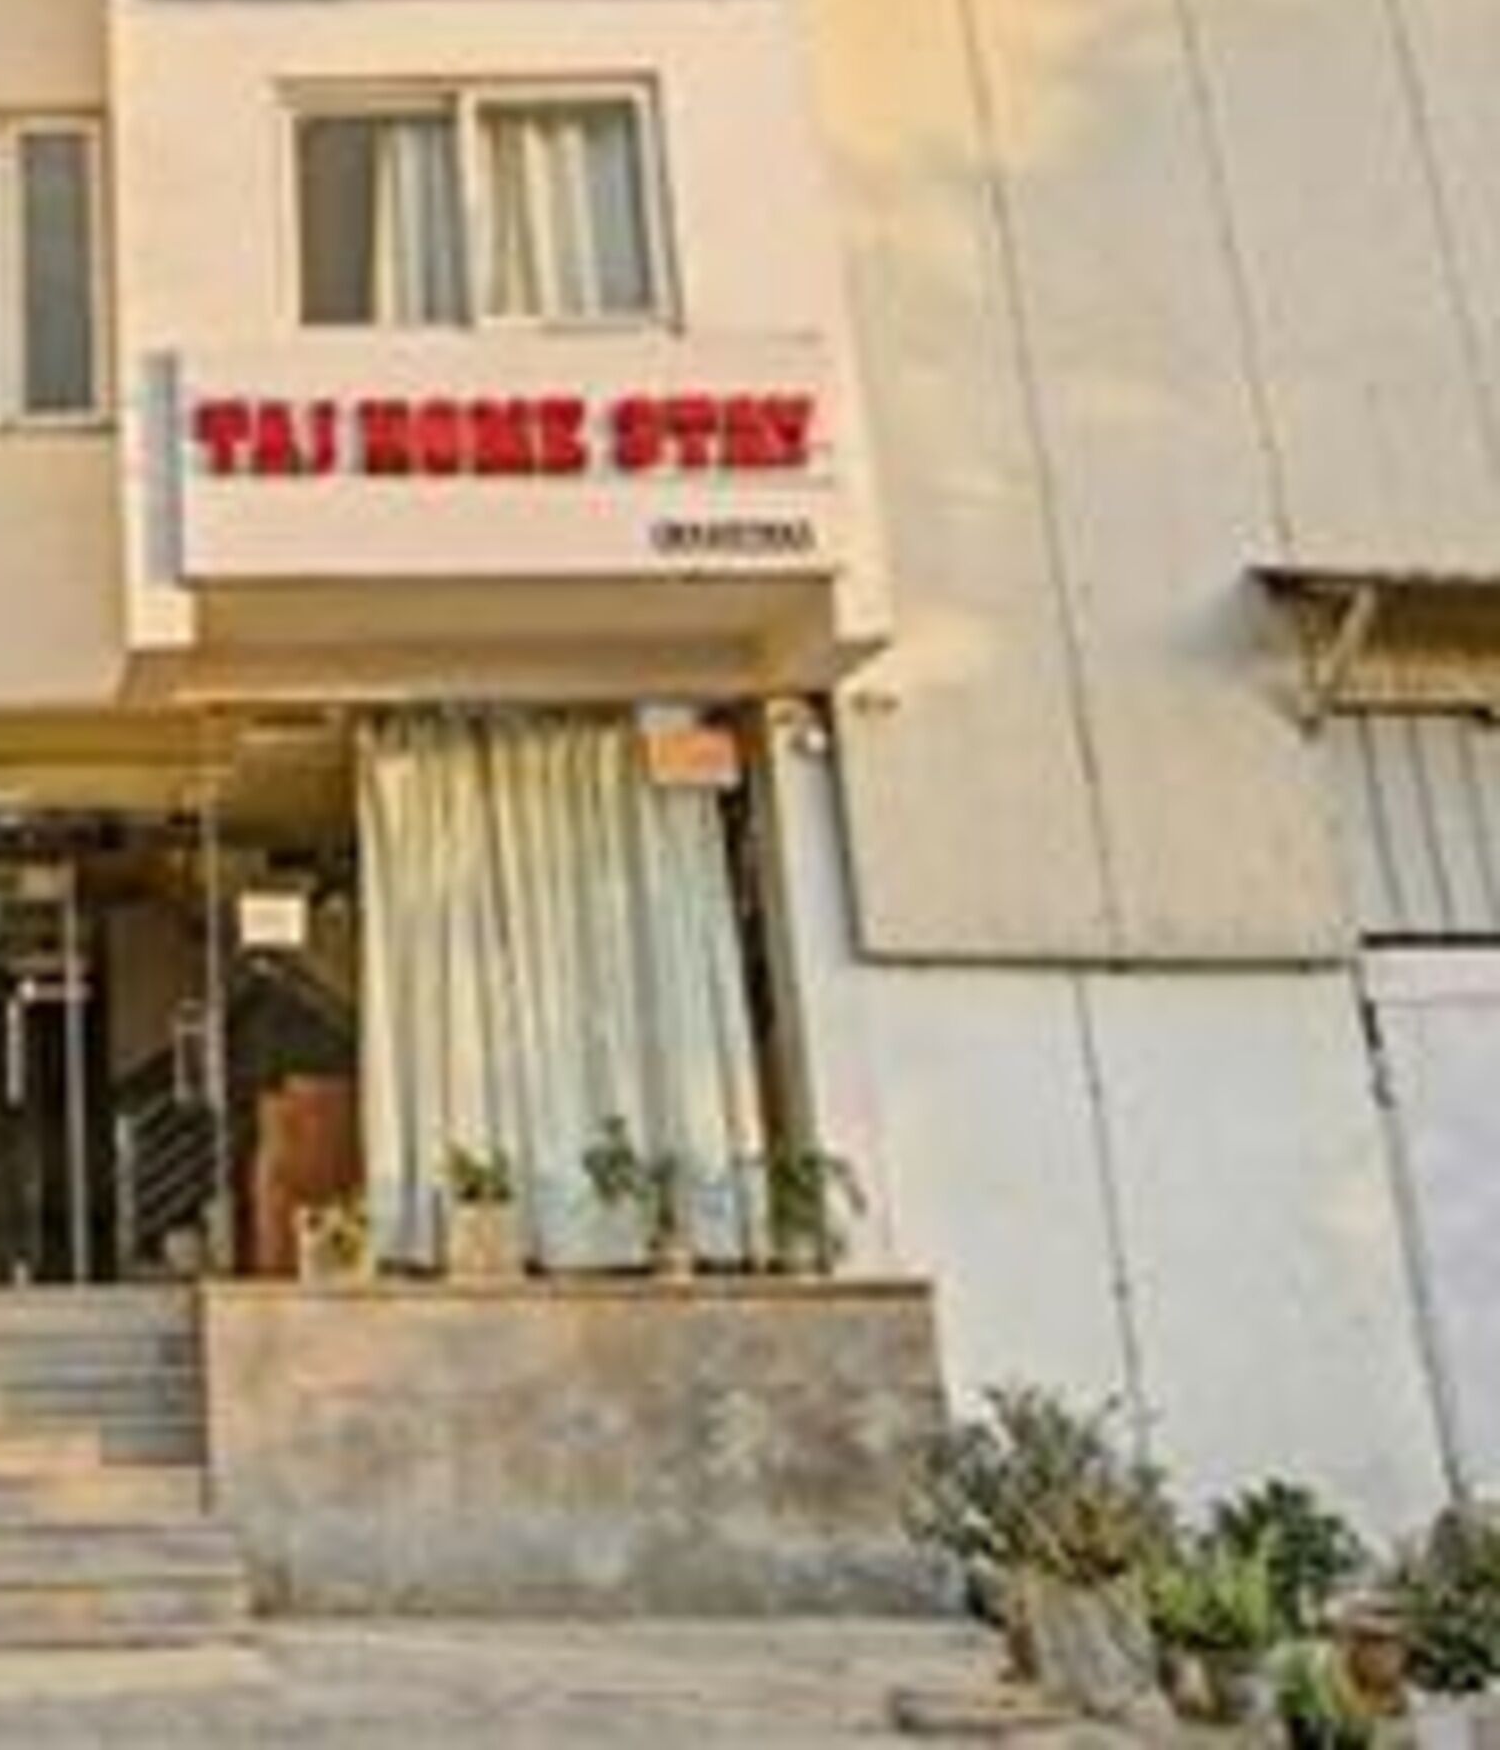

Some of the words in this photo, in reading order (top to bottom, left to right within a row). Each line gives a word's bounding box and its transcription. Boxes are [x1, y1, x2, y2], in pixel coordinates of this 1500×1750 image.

[192, 398, 336, 476] TAJ
[358, 397, 587, 474] HOME
[612, 393, 814, 470] STAY
